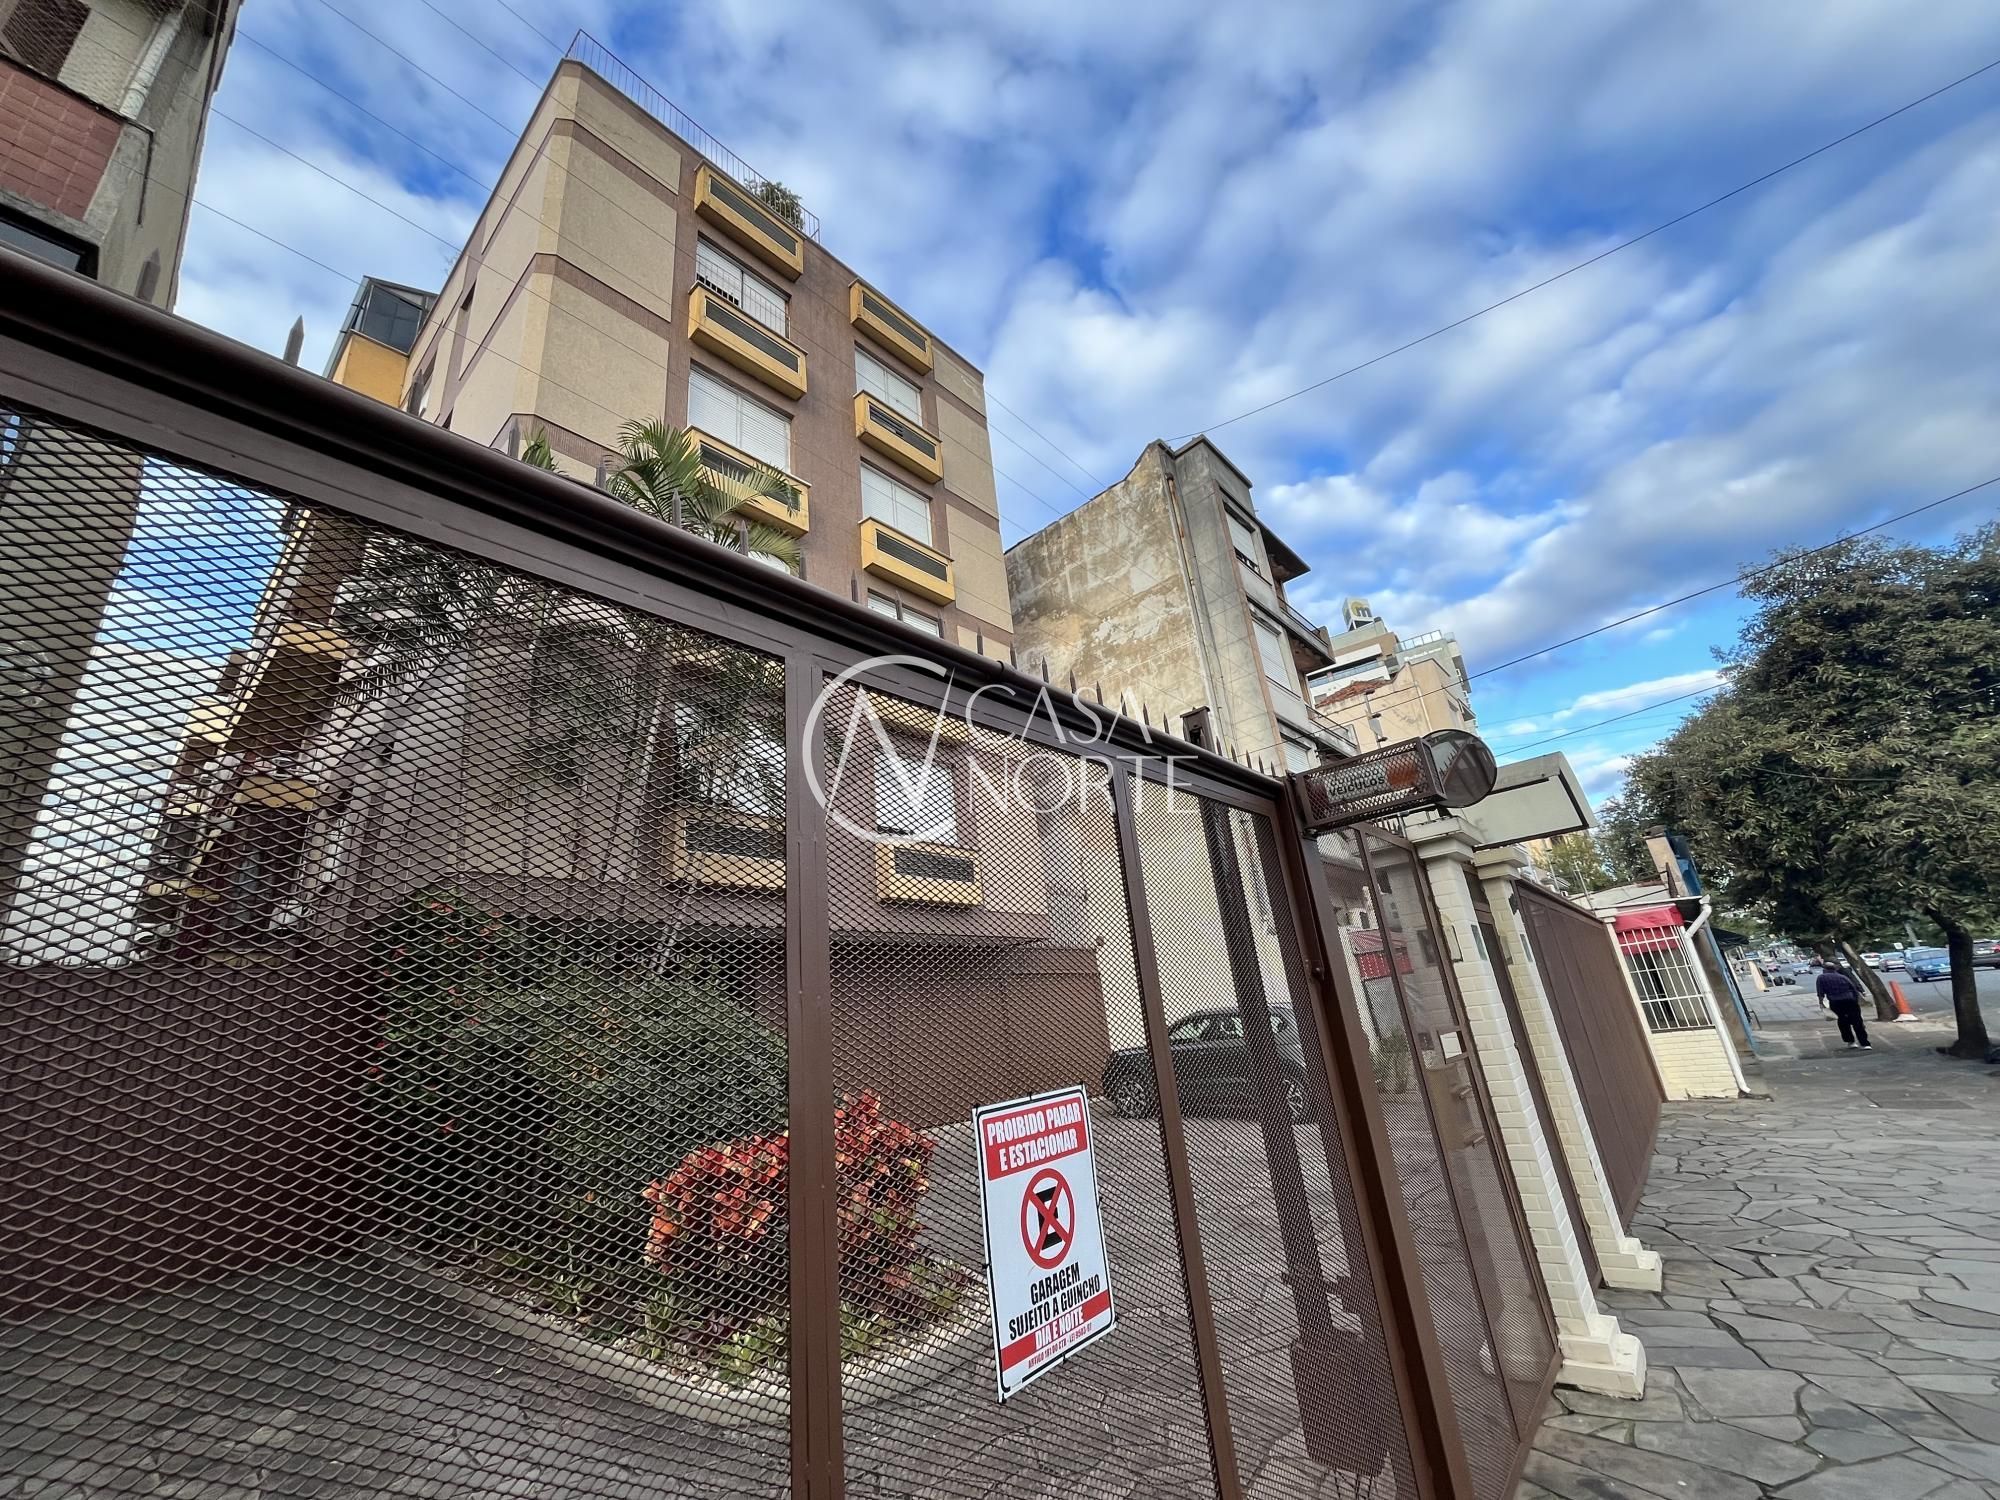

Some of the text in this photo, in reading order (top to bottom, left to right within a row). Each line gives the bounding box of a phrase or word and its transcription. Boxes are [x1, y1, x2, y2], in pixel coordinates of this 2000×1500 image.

[987, 1102, 1081, 1146] PROIBIDO PARAR
[999, 1129, 1078, 1172] E ESTACIONAR
[1030, 1261, 1080, 1305] GARAGEM
[1009, 1274, 1100, 1341] SUJEITO A GUINCHO
[1035, 1306, 1084, 1350] DIA E NOITE
